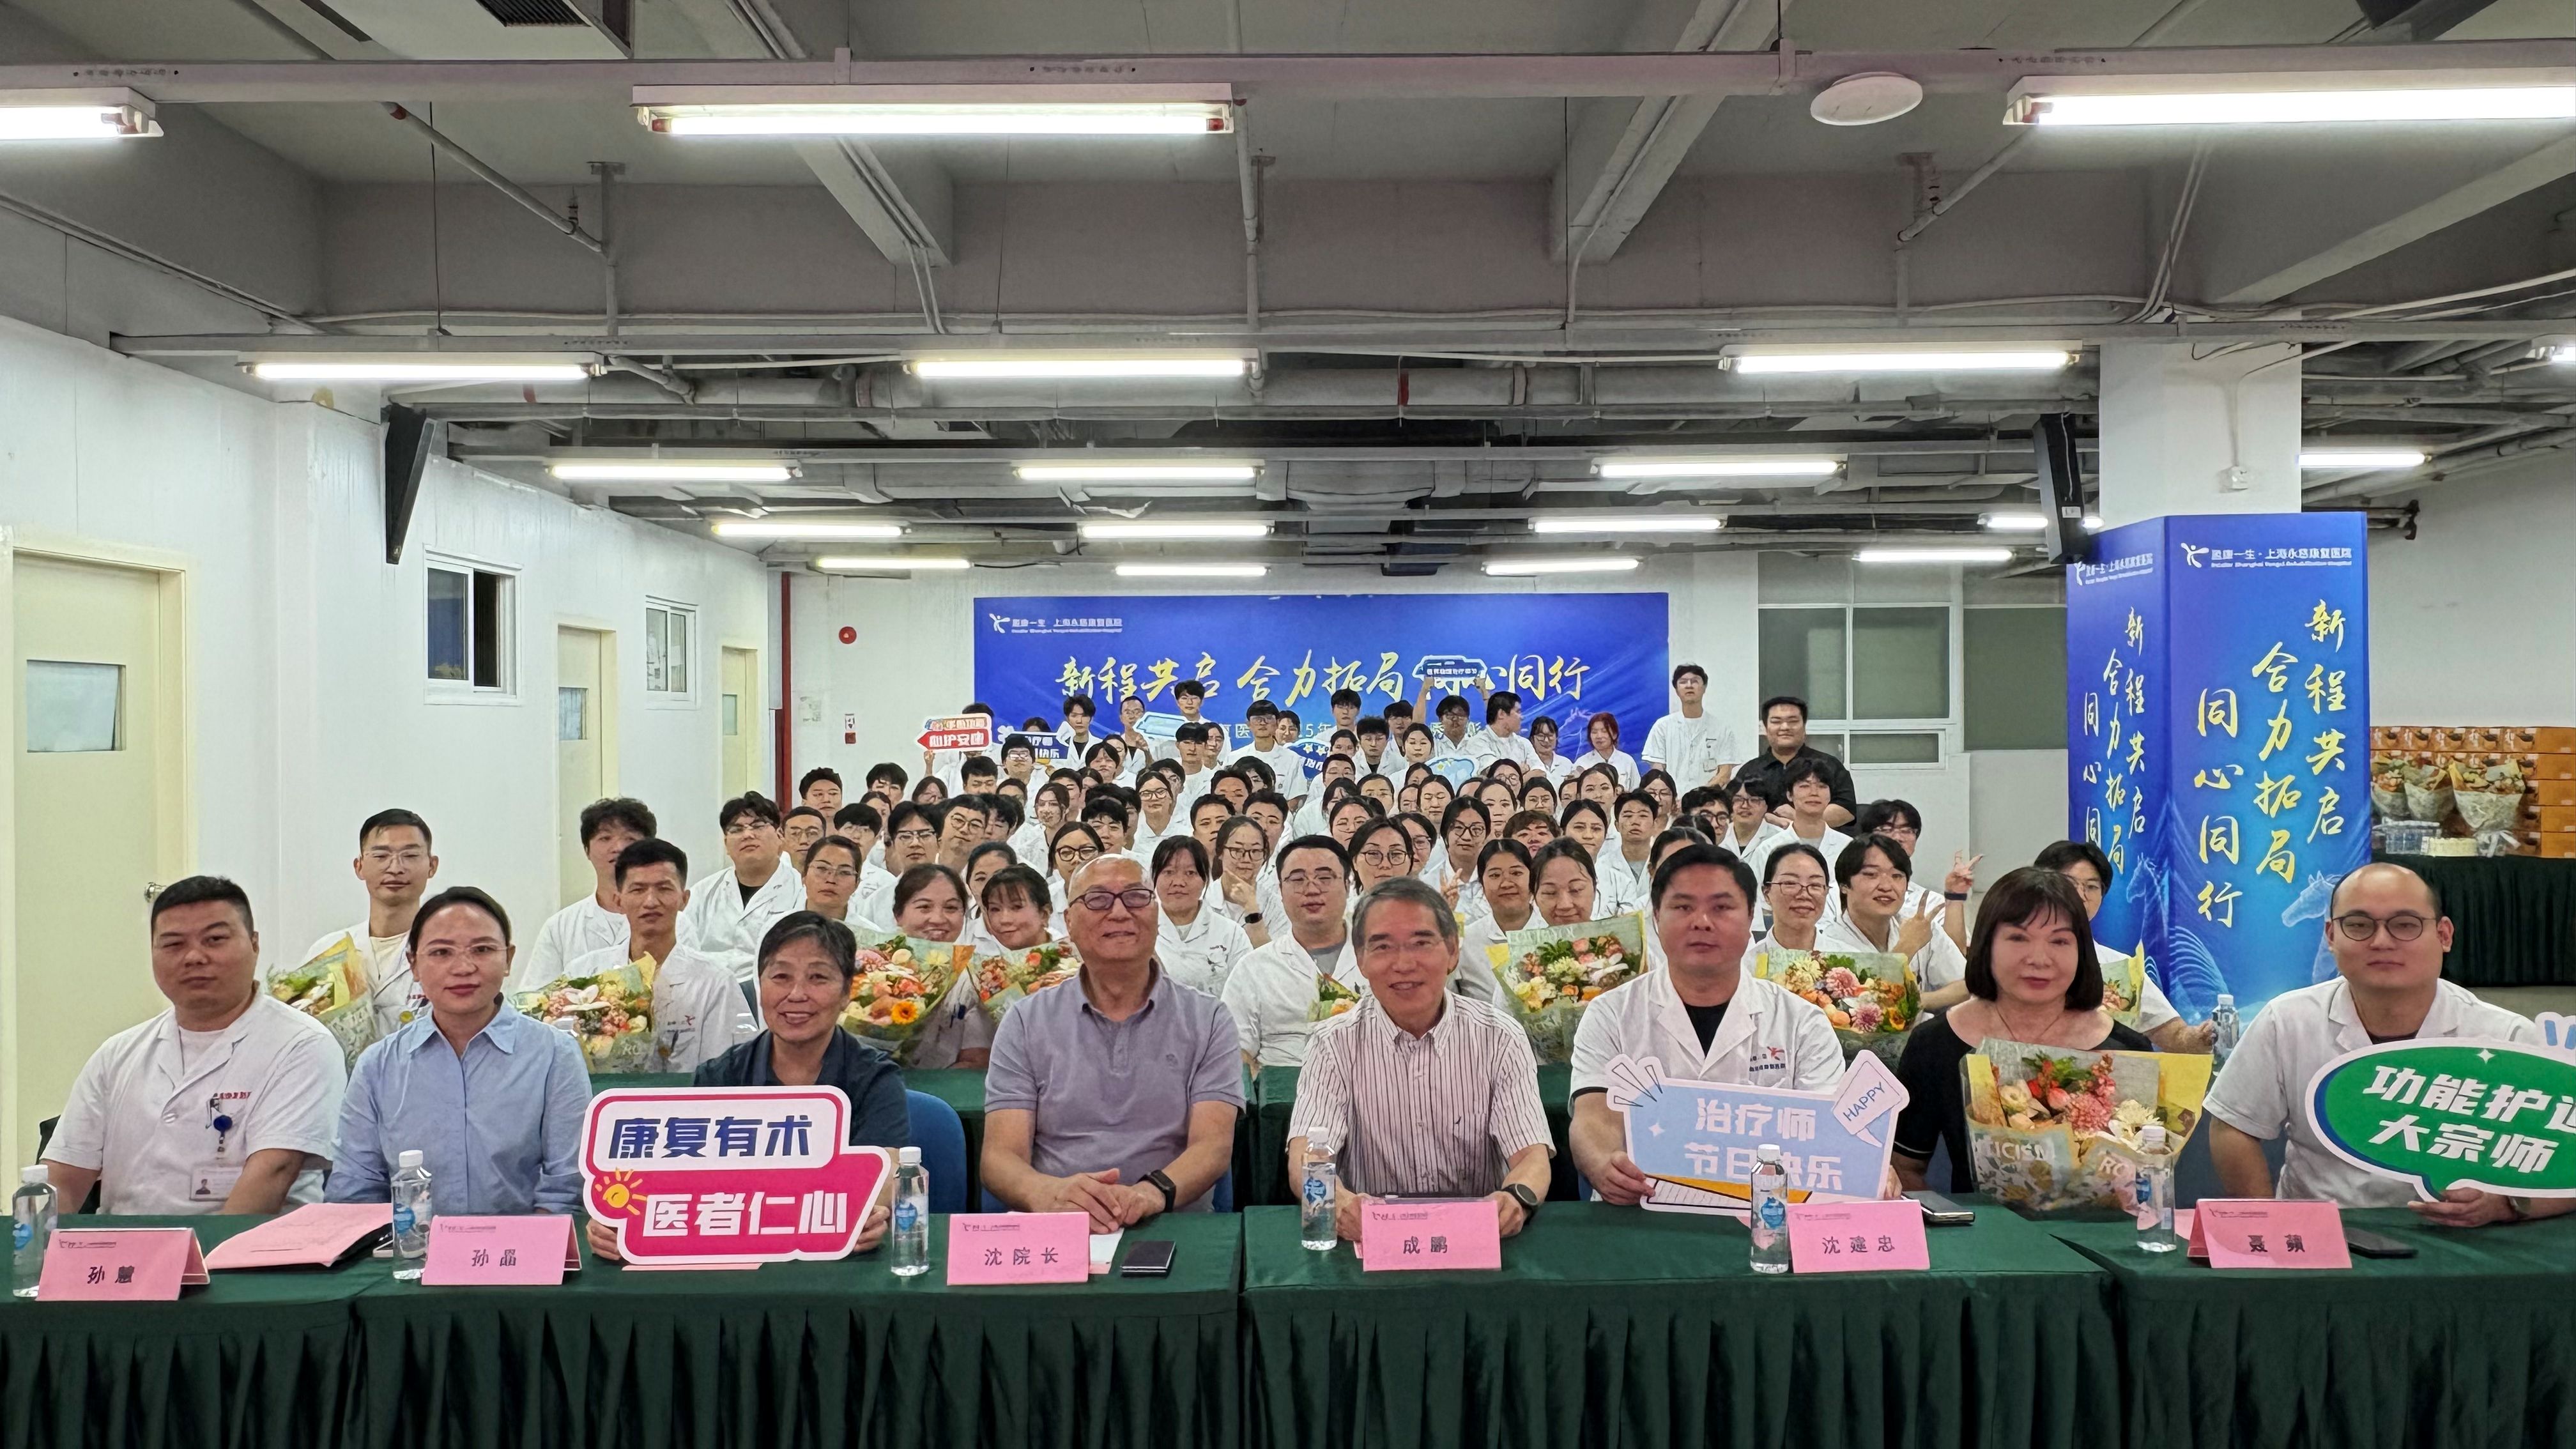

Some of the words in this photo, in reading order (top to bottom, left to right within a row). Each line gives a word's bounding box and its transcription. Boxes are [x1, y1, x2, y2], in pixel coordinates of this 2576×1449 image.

[1237, 649, 1404, 708] 合力拓局
[2124, 606, 2145, 839] 新程共启
[2304, 599, 2347, 844] 新程共启
[2103, 648, 2126, 875] 合力拓局
[2252, 641, 2301, 883] 合力拓局
[2194, 688, 2244, 928] 同心同行
[1695, 1098, 1816, 1141] 治疗师
[1843, 1081, 1885, 1121] HAPPY
[608, 1115, 812, 1158] 康复有术
[2368, 1114, 2559, 1173] 大宗师
[642, 1190, 847, 1238] 医者仁心
[985, 1247, 1059, 1266] 沈院长
